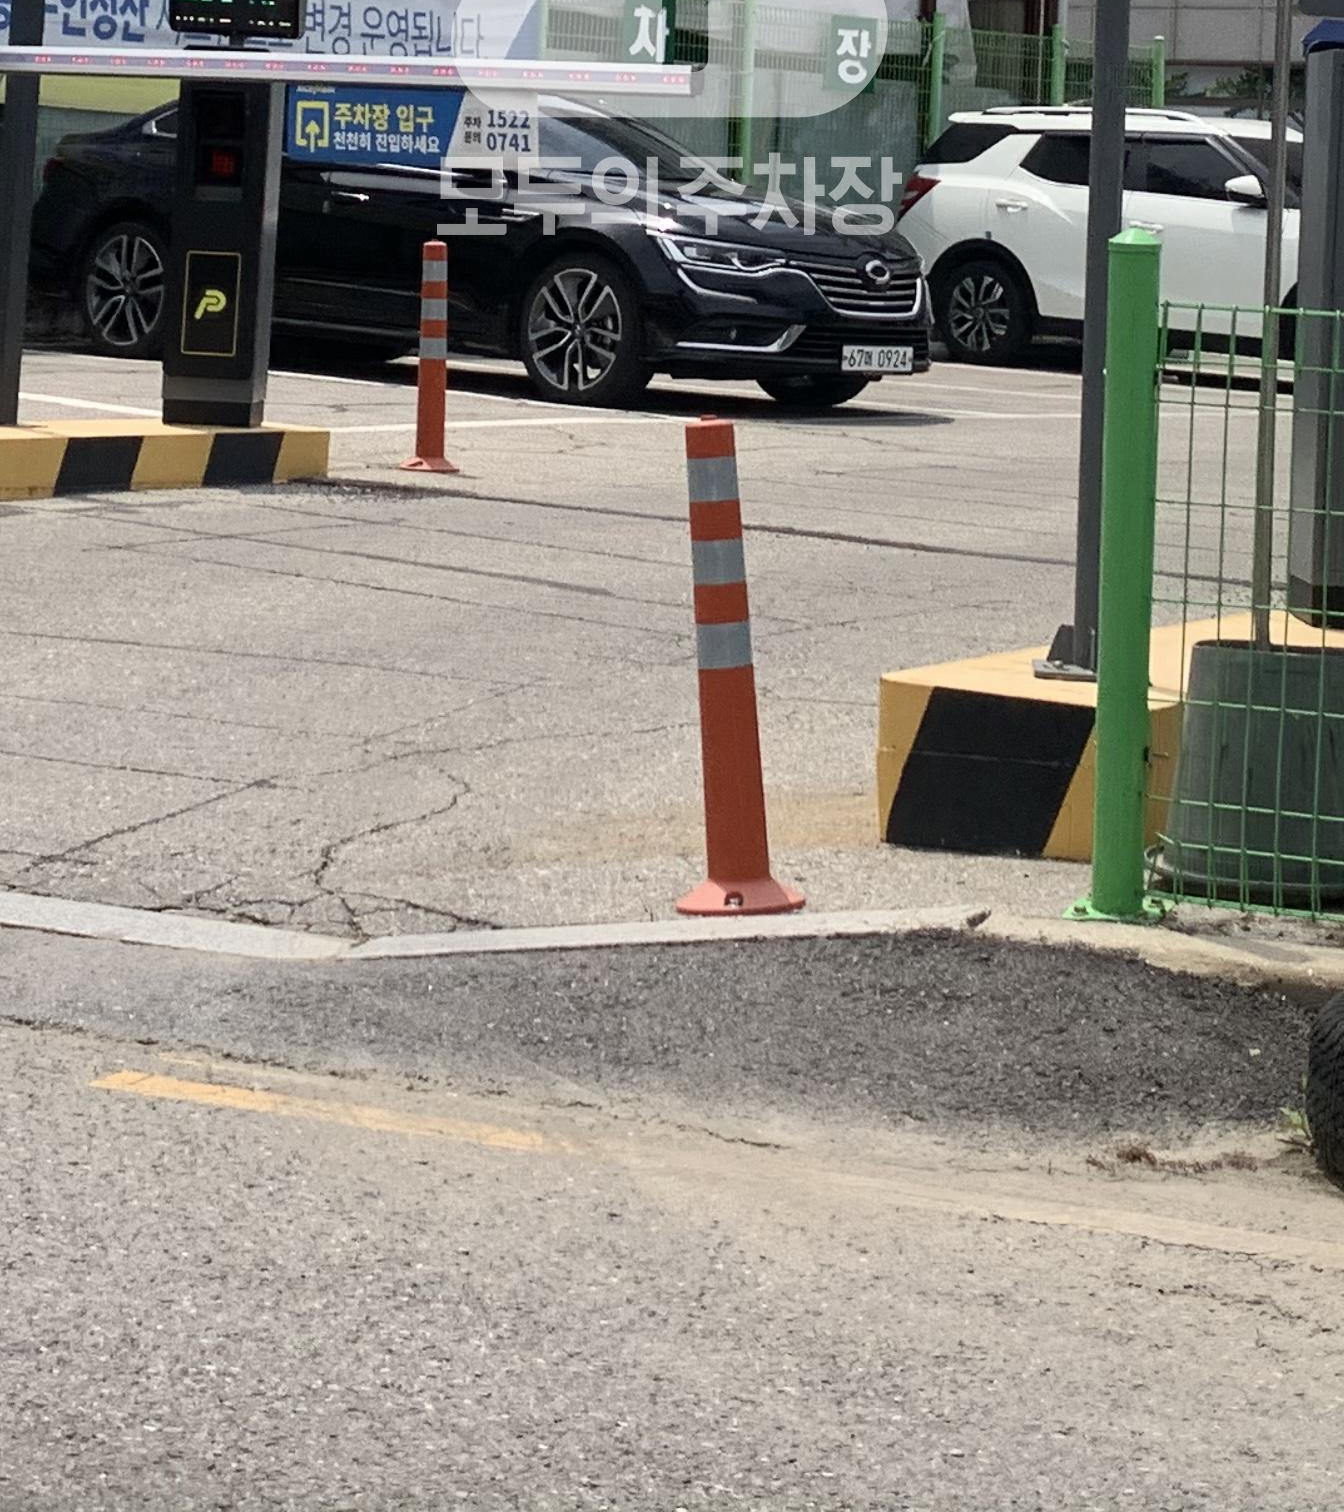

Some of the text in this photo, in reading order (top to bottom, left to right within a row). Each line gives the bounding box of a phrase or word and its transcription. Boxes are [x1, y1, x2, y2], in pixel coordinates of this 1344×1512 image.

[628, 4, 872, 84] 차 장
[333, 102, 435, 133] 주차장 입구
[487, 109, 531, 129] 1522
[333, 133, 441, 155] 천천히 진입하세요
[487, 132, 531, 152] 0741
